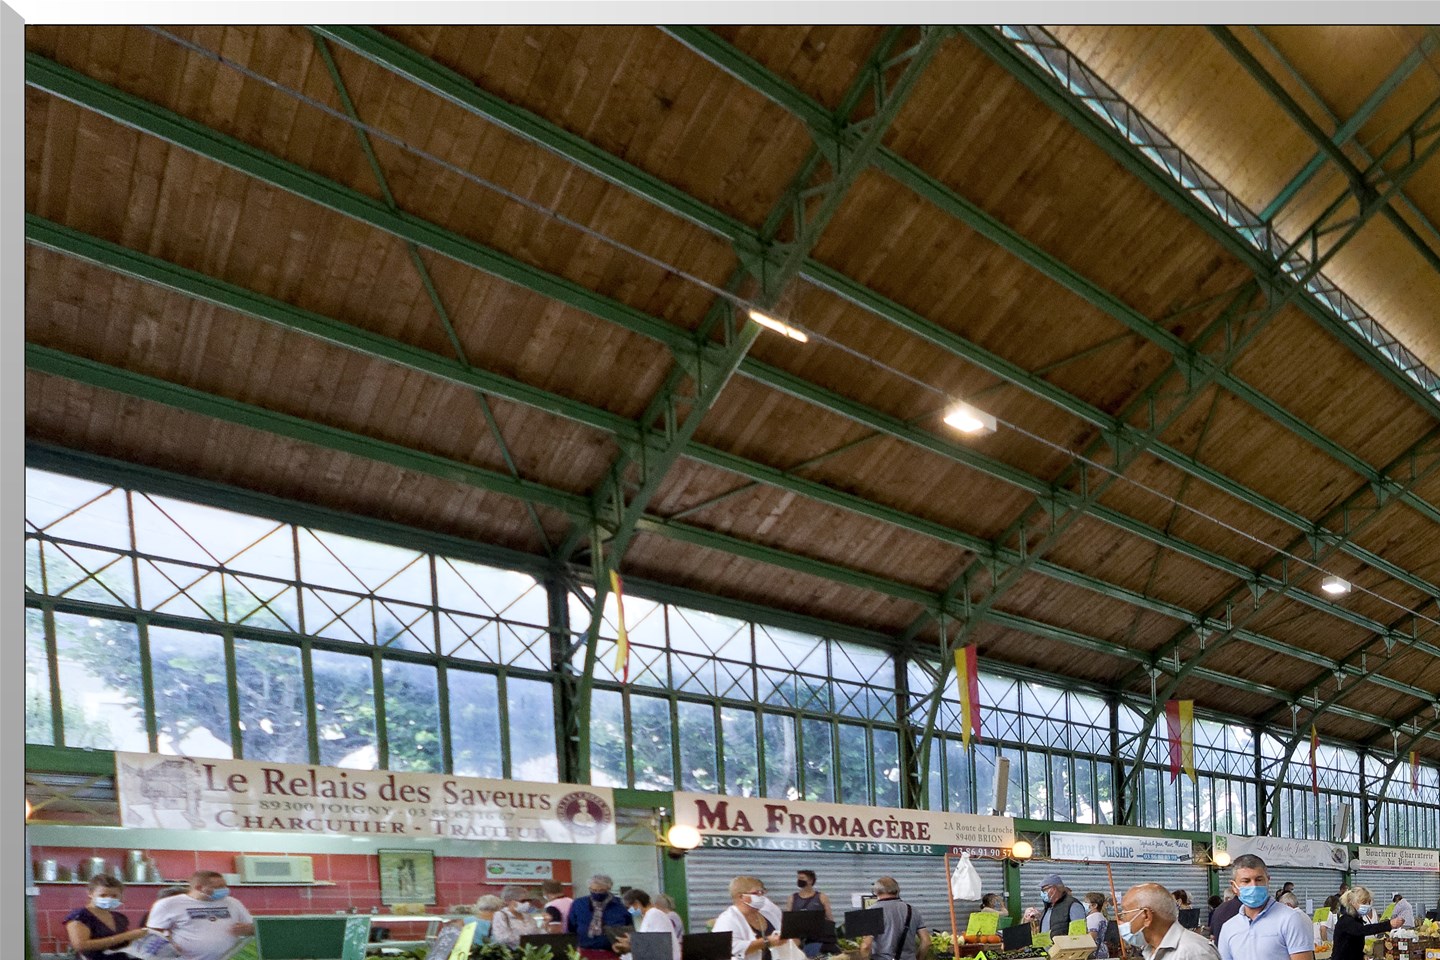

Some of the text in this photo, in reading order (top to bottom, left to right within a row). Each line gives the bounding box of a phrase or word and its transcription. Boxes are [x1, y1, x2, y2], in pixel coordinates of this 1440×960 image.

[202, 763, 551, 811] Le Relais des Saveurs
[259, 800, 314, 812] 89300
[320, 802, 392, 816] JOIGNY
[215, 810, 405, 834] CHARCUTIER
[429, 819, 549, 839] TRAITEUR
[695, 800, 931, 841] MA FROMAGÈRE
[943, 822, 1013, 834] 2A Route de Laroche
[699, 836, 822, 850] FROMAGER
[839, 841, 933, 854] AFFINEUR
[978, 834, 1003, 843] BRION
[978, 847, 988, 856] 91
[990, 848, 1000, 857] 90
[1002, 849, 1012, 857] 57
[1053, 837, 1134, 859] Traiteur Cuisine
